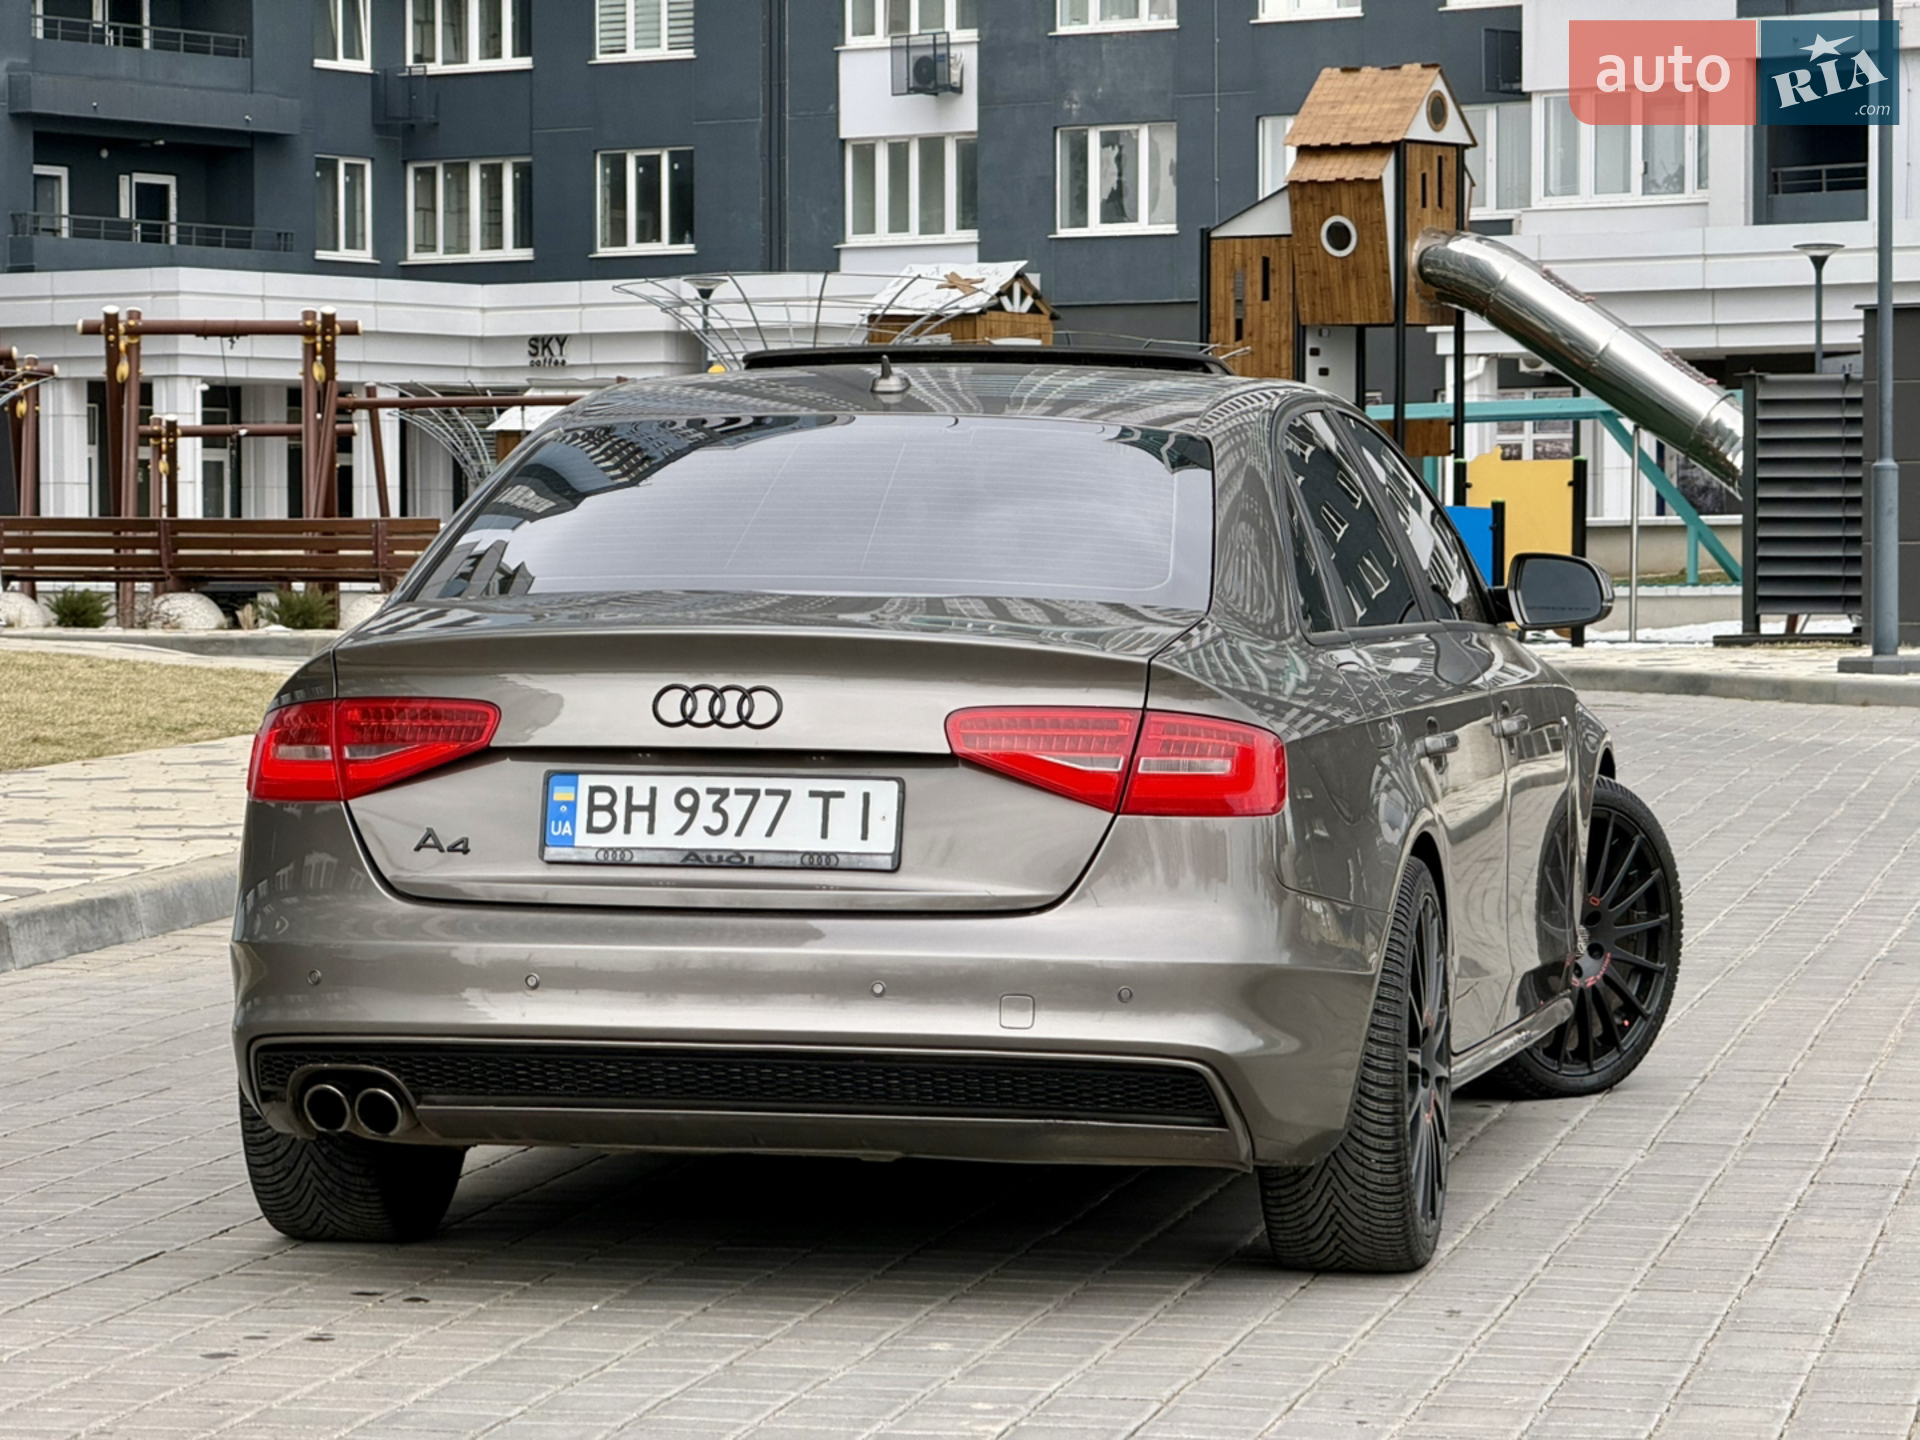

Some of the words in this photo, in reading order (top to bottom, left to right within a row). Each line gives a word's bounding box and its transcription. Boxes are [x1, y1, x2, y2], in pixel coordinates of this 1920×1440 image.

[528, 335, 569, 357] SKY
[530, 357, 567, 367] coffee
[586, 785, 657, 835] BH
[673, 787, 792, 838] 9377
[808, 790, 871, 841] TI
[551, 820, 573, 836] UA
[413, 827, 471, 855] A4
[680, 850, 755, 865] Audi
